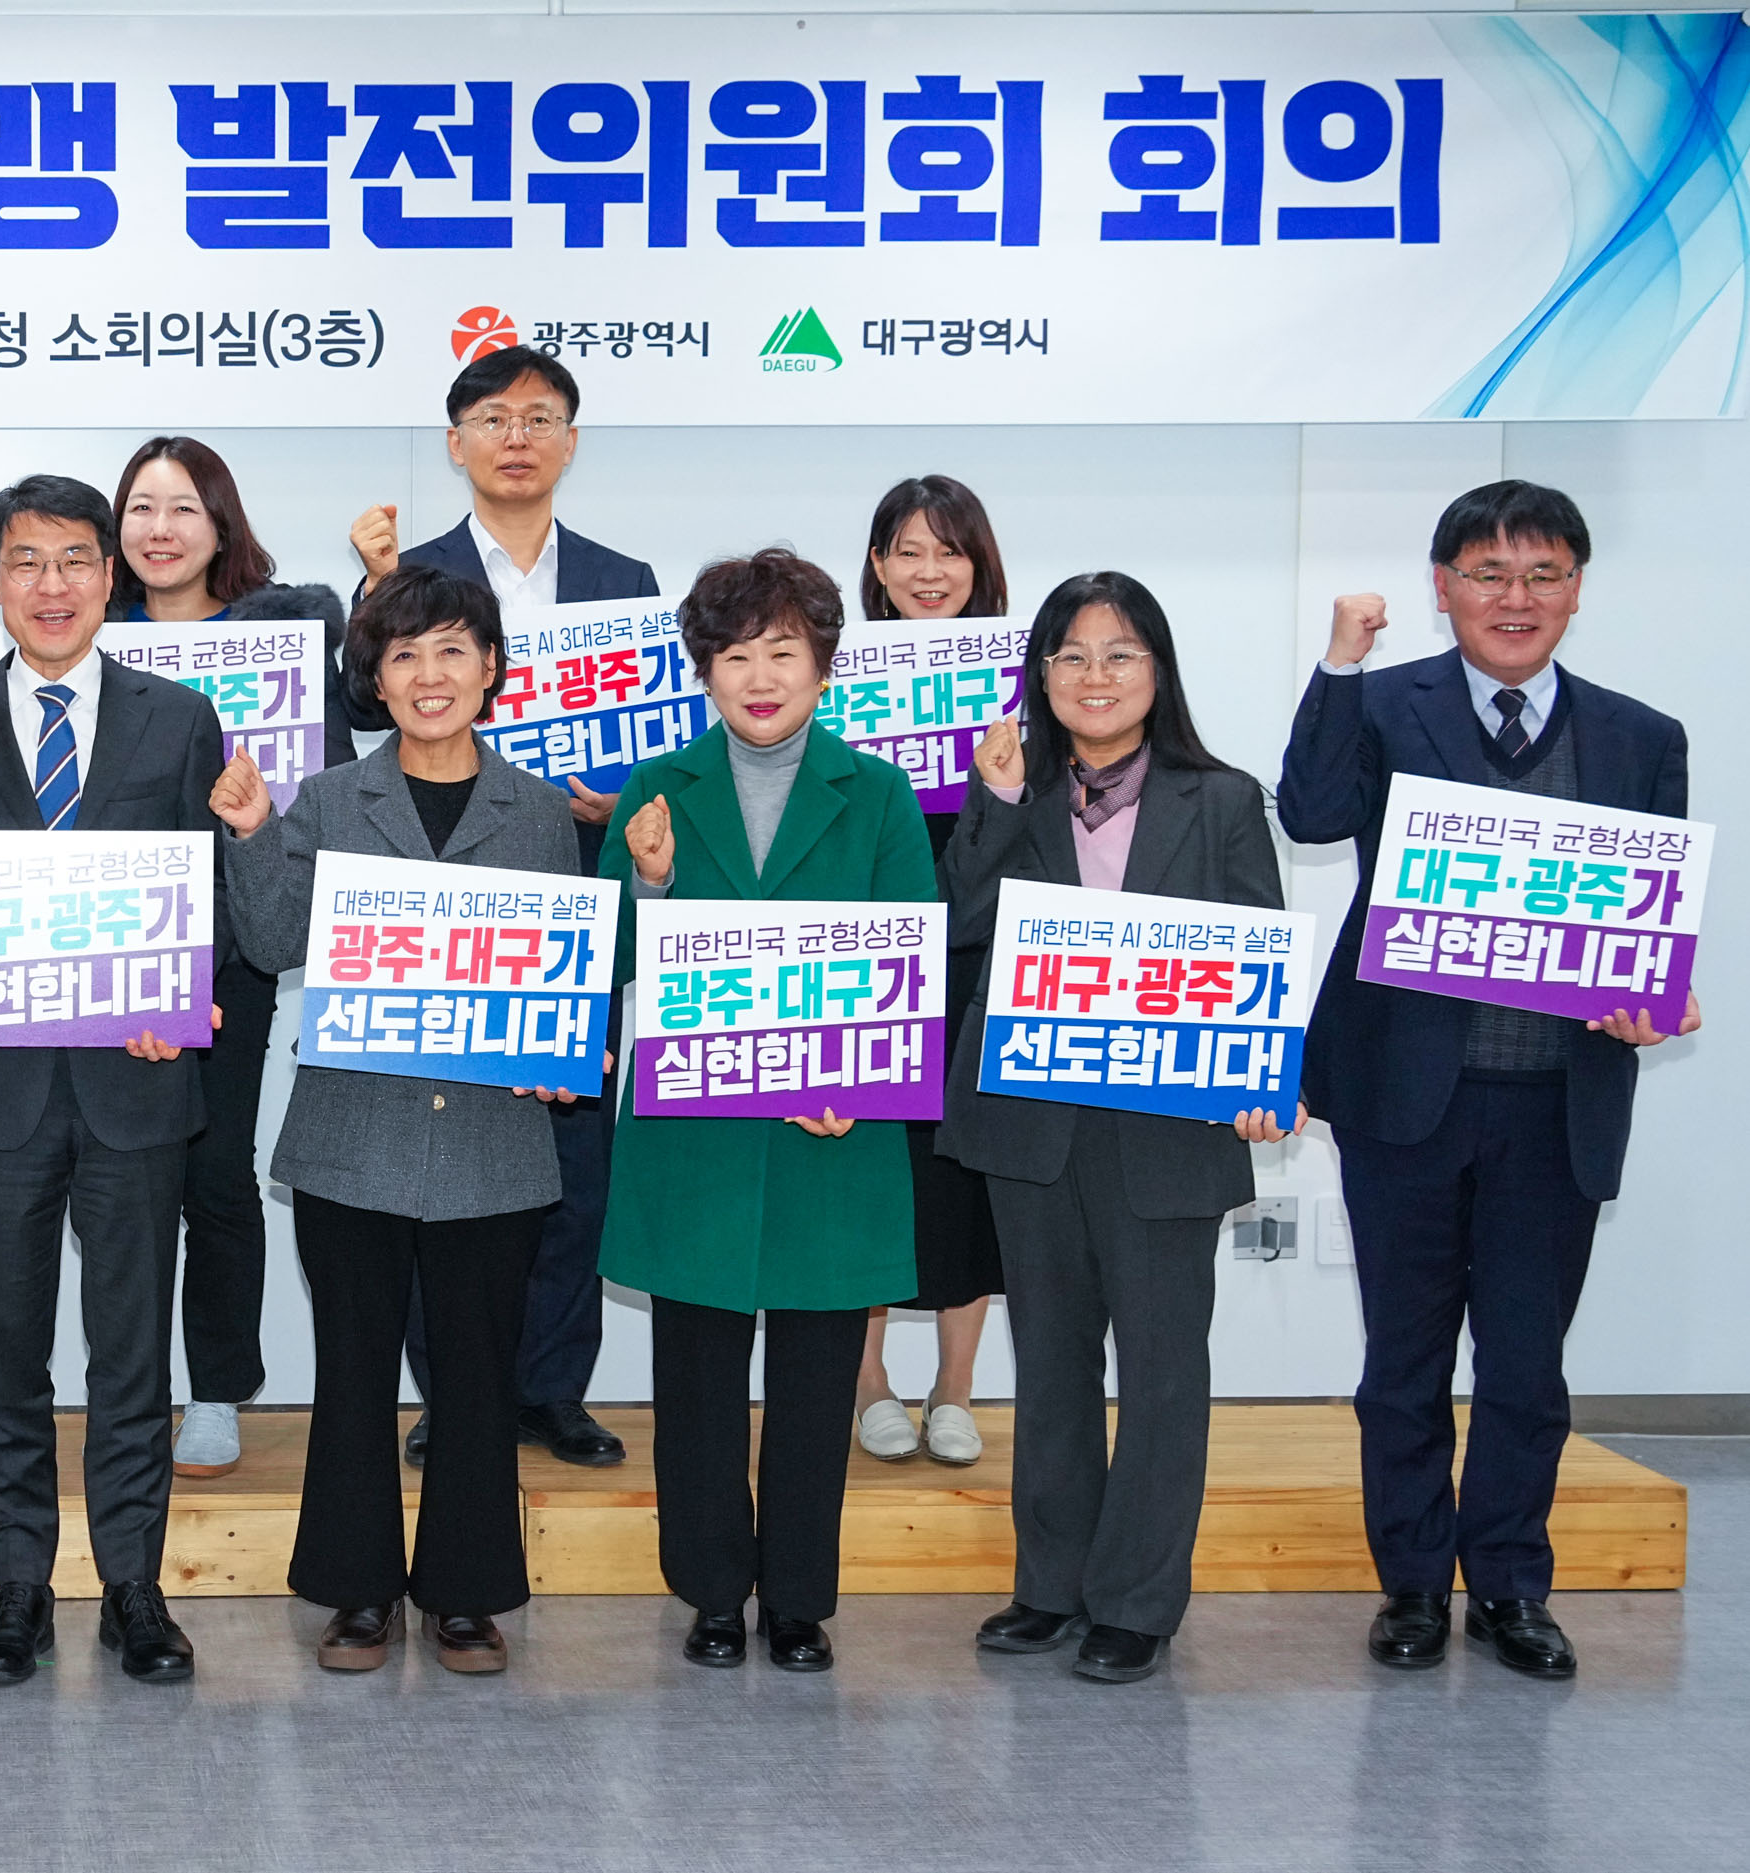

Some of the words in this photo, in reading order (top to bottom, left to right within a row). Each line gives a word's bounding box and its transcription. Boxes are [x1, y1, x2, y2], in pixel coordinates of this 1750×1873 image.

[168, 74, 1044, 250] 발전위원회
[1099, 74, 1445, 246] 회의
[49, 307, 386, 369] 소회의실(3층)
[531, 320, 710, 358] 광주광역시
[862, 317, 1050, 357] 대구광역시
[762, 358, 817, 372] DAEGU
[192, 631, 307, 670] 균형성장
[537, 630, 554, 656] AI
[560, 617, 634, 652] 3대강국
[832, 642, 917, 679] 한민국
[1406, 810, 1542, 850] 대한민국
[1552, 822, 1693, 863] 균형성장
[66, 844, 195, 886] 균형성장
[1395, 847, 1684, 926] 대구·광주가
[333, 888, 427, 918] 대한민국
[432, 891, 453, 919] AI
[459, 891, 543, 920] 3대강국
[551, 893, 598, 921] 실현
[328, 924, 595, 987] 광주·대구가
[658, 926, 786, 964] 대한민국
[797, 915, 928, 955] 균형성장
[1017, 918, 1115, 948] 대한민국
[1120, 921, 1142, 949] AI
[1148, 921, 1237, 952] 3대강국
[1243, 925, 1293, 954] 실현
[1382, 912, 1674, 996] 실현합니다!
[657, 953, 927, 1030] 광주·대구가
[1010, 953, 1290, 1020] 대구·광주가
[316, 993, 592, 1058] 선도합니다!
[654, 1023, 924, 1101] 실현합니다!
[999, 1022, 1286, 1092] 선도합니다!
